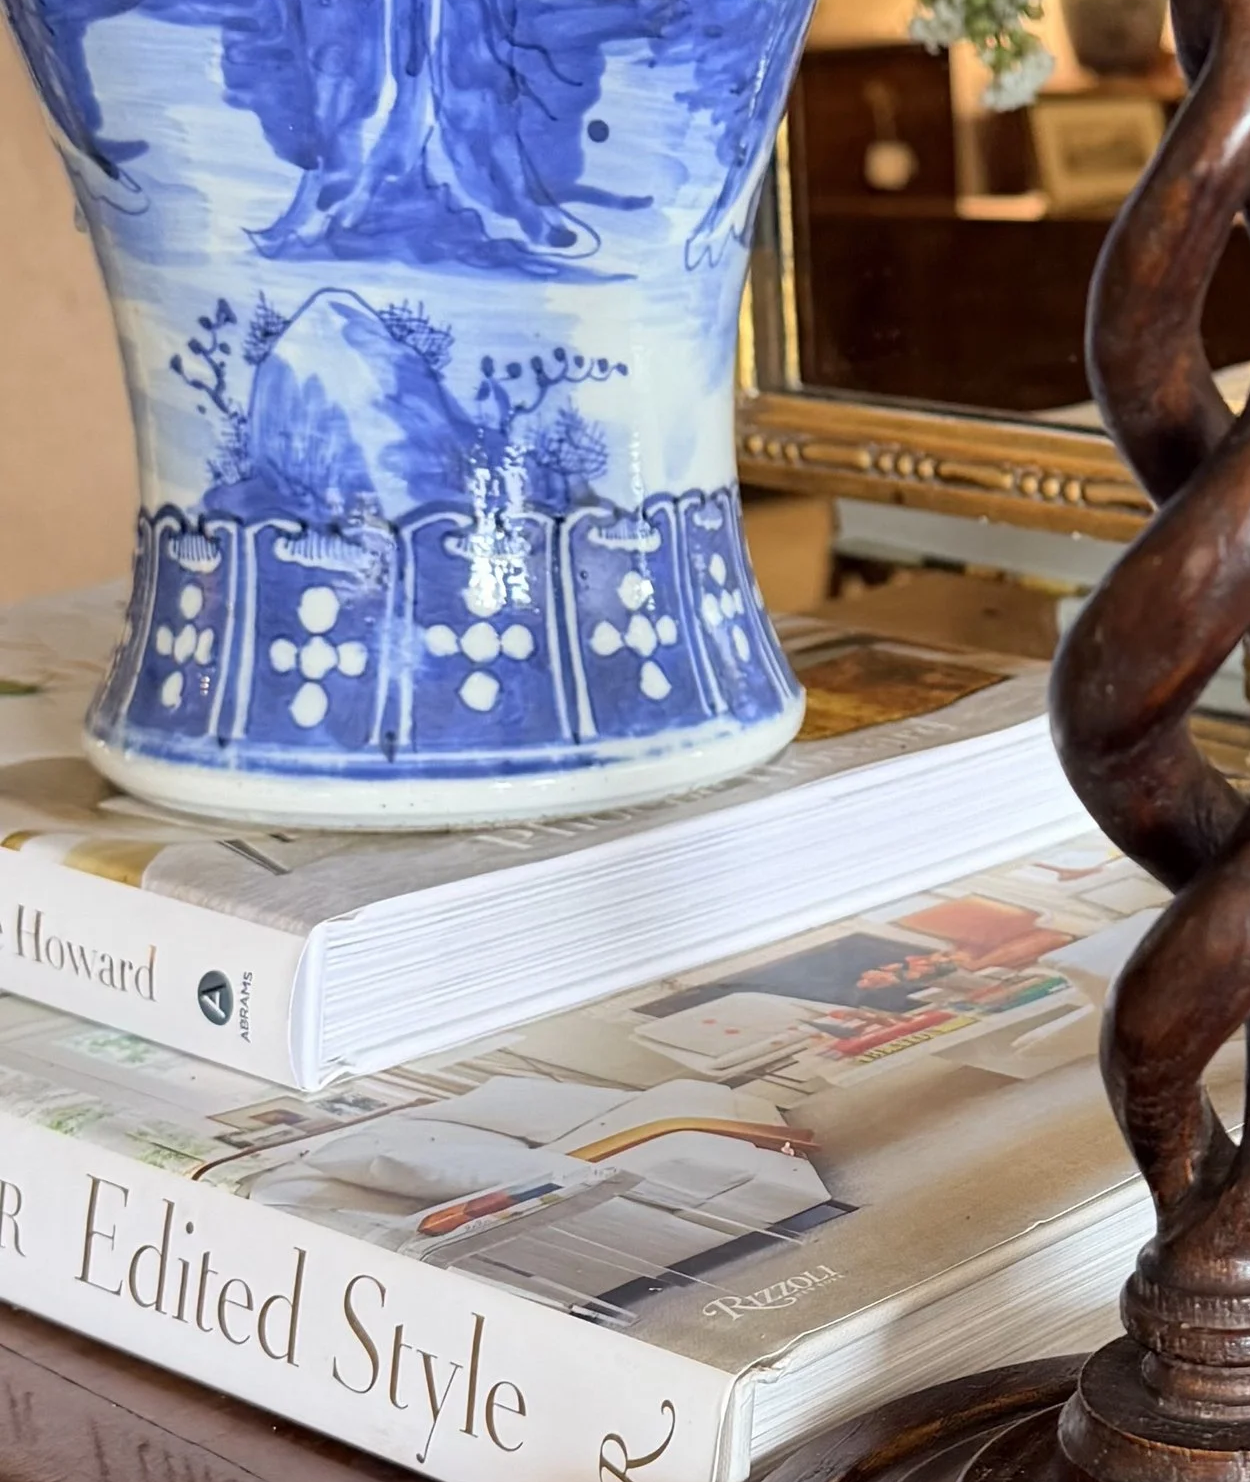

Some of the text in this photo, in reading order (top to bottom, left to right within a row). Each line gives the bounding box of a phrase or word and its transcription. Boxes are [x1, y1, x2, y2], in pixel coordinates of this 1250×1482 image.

[13, 903, 160, 1003] Howard
[239, 971, 253, 1043] ABRAMS
[74, 1173, 307, 1368] Edited
[332, 1274, 527, 1465] Style
[702, 1264, 838, 1320] RIZZOLI
